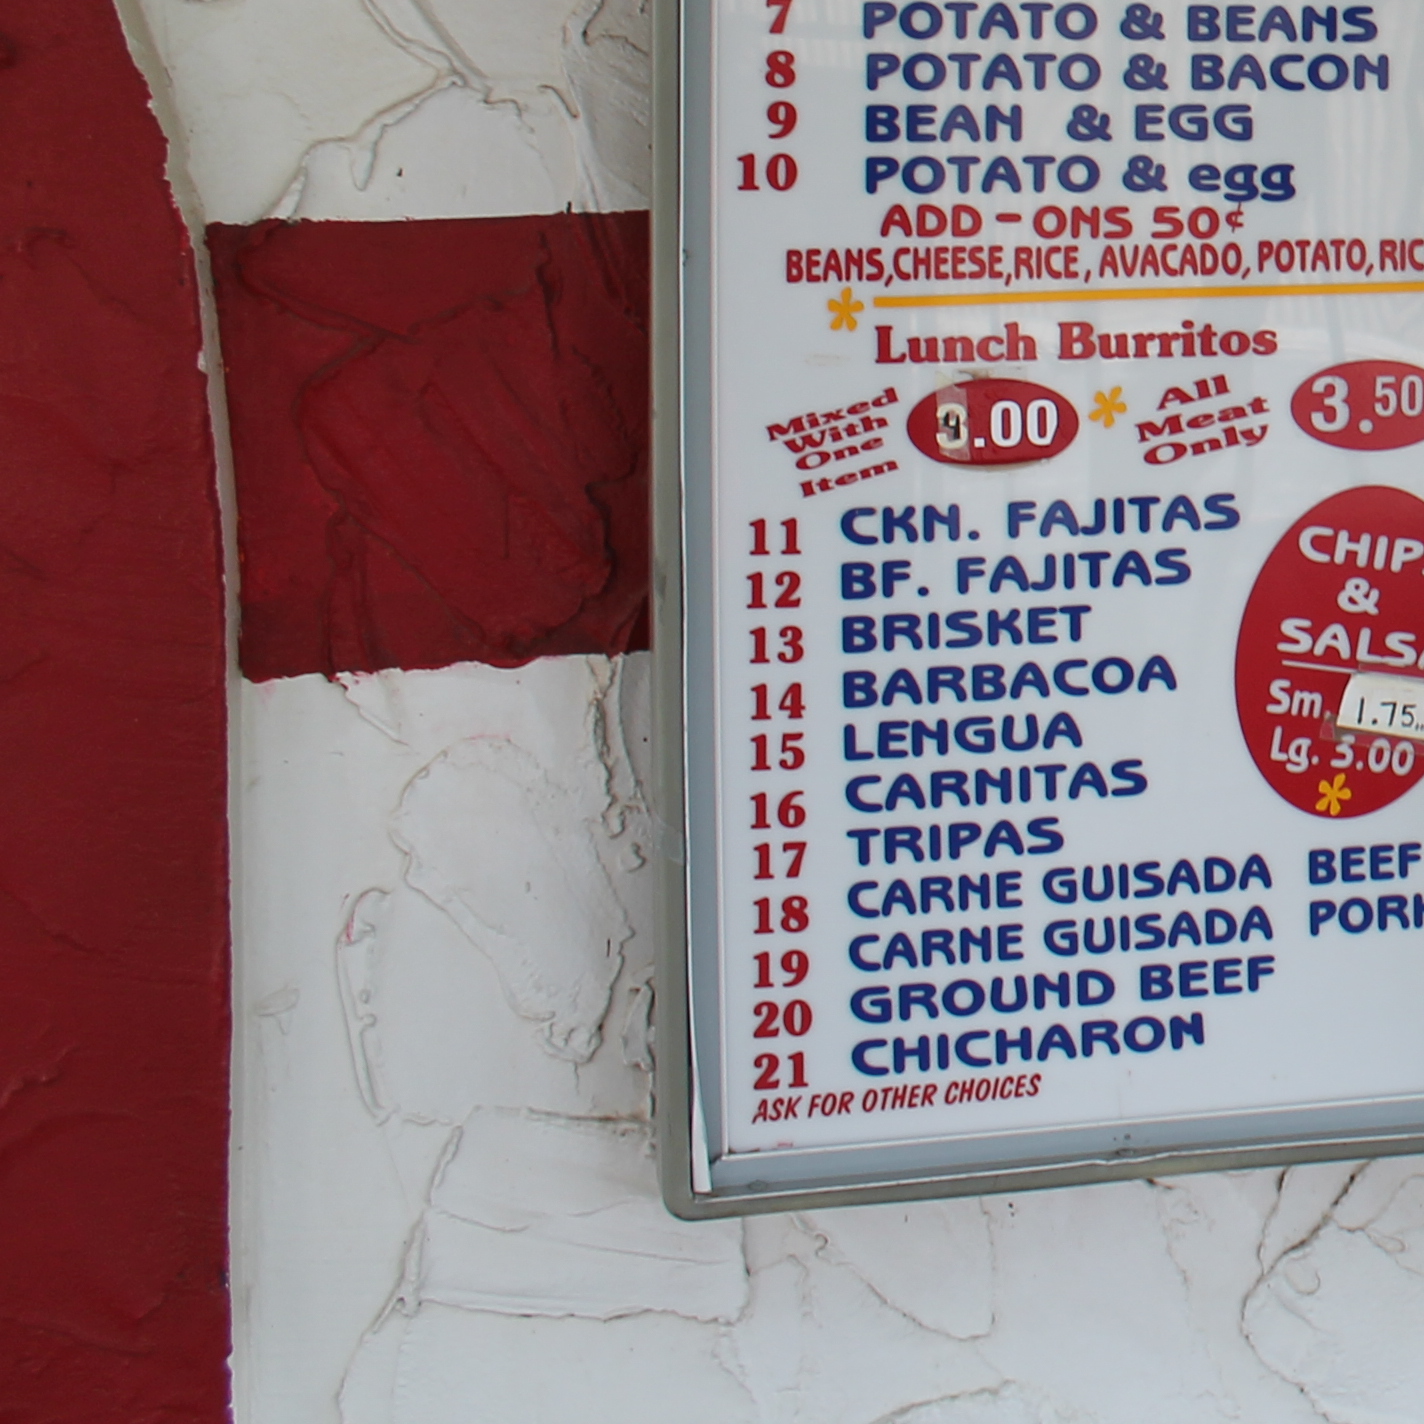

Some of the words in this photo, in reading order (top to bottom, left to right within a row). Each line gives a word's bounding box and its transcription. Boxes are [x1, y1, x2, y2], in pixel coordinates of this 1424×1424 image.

[767, 100, 798, 139] 9
[863, 103, 1021, 144] BEAN
[1065, 104, 1111, 143] &
[1133, 104, 1252, 143] EGG
[739, 152, 798, 192] 10
[863, 155, 1099, 196] POTATO
[1120, 155, 1166, 194] &
[1187, 164, 1295, 204] egg
[1099, 242, 1251, 278] AVACADO,
[1258, 238, 1374, 275] POTATO,
[876, 322, 1038, 364] Lunch
[1059, 319, 1278, 360] Burritos
[766, 387, 899, 442] Mixed
[1159, 374, 1230, 410] All
[1309, 376, 1424, 435] 3.50
[783, 415, 890, 455] With
[1136, 395, 1271, 444] Meat
[1137, 413, 1268, 465] Only
[795, 437, 885, 471] One
[799, 459, 899, 498] Item
[1337, 577, 1379, 615] &
[752, 682, 806, 720] 14
[840, 656, 1177, 711] BARBACOA
[1355, 696, 1418, 727] 1.75
[1270, 725, 1320, 774] Lg.
[755, 895, 810, 934] 18
[845, 872, 1023, 921] CARNE
[1040, 854, 1273, 906] GUISADA
[1307, 843, 1423, 887] BEEF
[754, 1051, 809, 1090] 21
[849, 1013, 1205, 1079] CHICHARON
[756, 1097, 800, 1120] ASK
[809, 1091, 855, 1116] FOR
[863, 1083, 938, 1112] OTHER
[945, 1073, 1042, 1104] CHOICES
